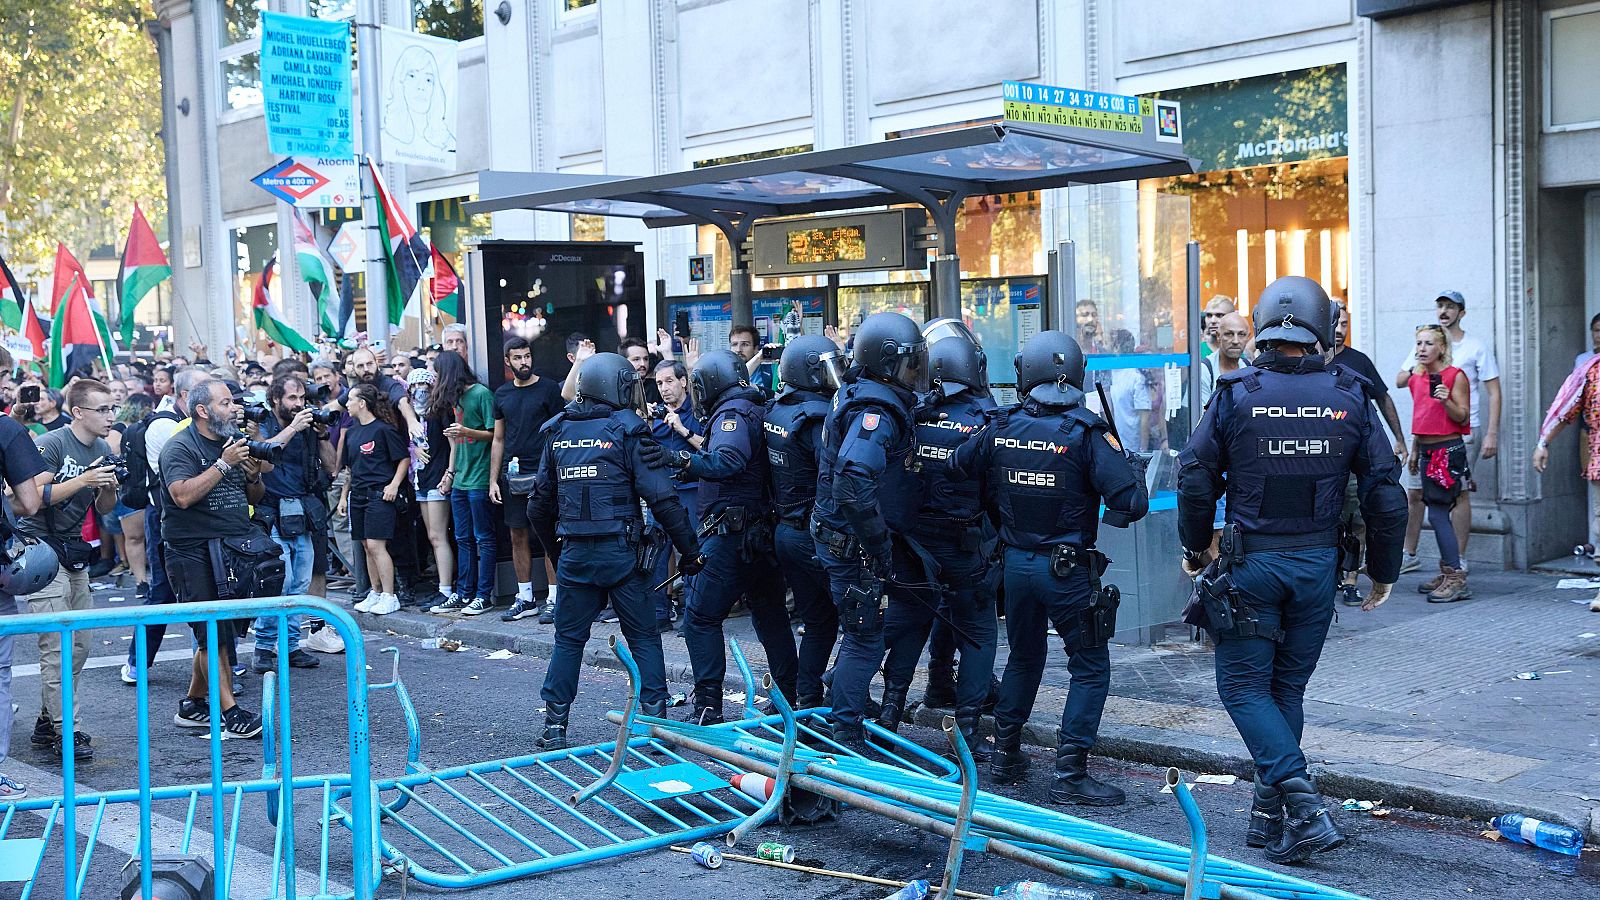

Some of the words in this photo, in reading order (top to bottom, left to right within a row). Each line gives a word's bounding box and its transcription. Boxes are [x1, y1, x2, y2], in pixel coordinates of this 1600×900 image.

[266, 31, 295, 44] MICHEL
[271, 45, 304, 59] ADRIANA
[306, 50, 342, 63] CAVARERO
[283, 61, 311, 74] CAMILA
[313, 66, 332, 76] SOSA
[271, 74, 306, 88] MICHAEL
[307, 77, 343, 91] IGNATIEFF
[279, 89, 316, 102] HARTMUT
[318, 93, 336, 105] ROSA
[1004, 83, 1020, 98] 001
[1022, 86, 1033, 100] 10
[1038, 88, 1049, 102] 14
[1054, 90, 1065, 104] 27
[1069, 92, 1080, 106] 34
[1084, 94, 1094, 107] 37
[1099, 96, 1109, 109] 45
[1111, 97, 1125, 112] C03
[1128, 102, 1136, 114] E1
[1142, 105, 1150, 115] N9
[267, 102, 301, 114] FESTIVAL
[338, 109, 349, 118] DE
[268, 112, 281, 123] LAS
[327, 118, 349, 128] IDEAS
[1006, 109, 1020, 120] N10
[1022, 111, 1035, 122] N11
[1038, 112, 1051, 123] N12
[1054, 114, 1067, 125] N13
[1069, 115, 1082, 127] N14
[1084, 117, 1097, 128] N15
[1099, 119, 1112, 130] N17
[1114, 120, 1127, 132] N25
[1129, 122, 1142, 133] N26
[262, 177, 285, 186] Metro
[292, 177, 306, 186] 400
[550, 254, 582, 262] JCDecaux
[1252, 406, 1335, 418] POLICIA
[764, 421, 785, 435] POLICIA
[552, 438, 602, 450] POLICIA
[994, 437, 1057, 451] POLICIA
[1268, 439, 1330, 455] UC431
[560, 465, 598, 480] UC226
[1008, 470, 1056, 487] UC262
